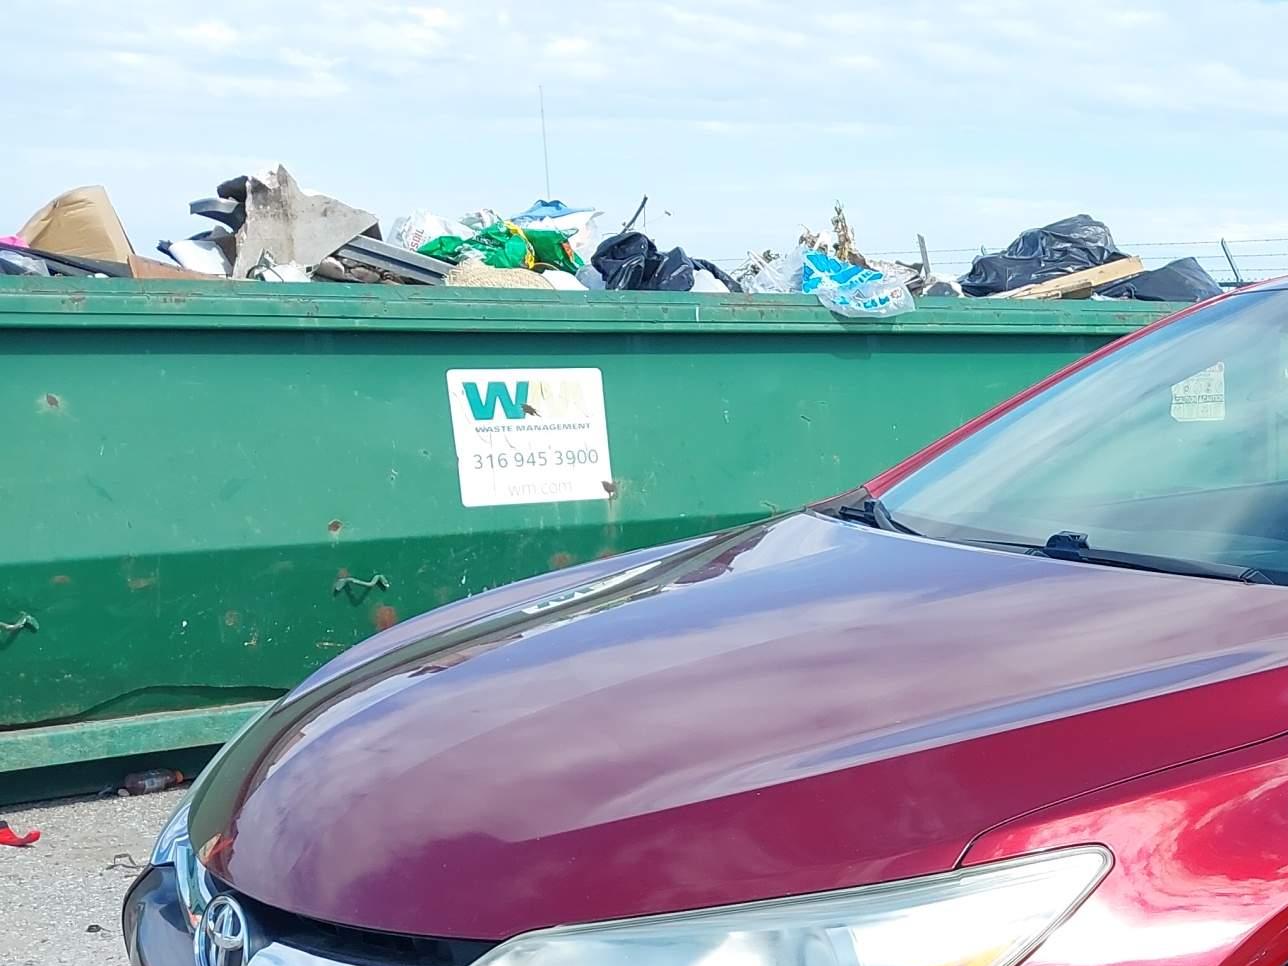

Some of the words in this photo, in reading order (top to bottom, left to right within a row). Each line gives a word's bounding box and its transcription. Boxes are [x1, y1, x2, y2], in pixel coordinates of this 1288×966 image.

[474, 424, 513, 433] WASTE
[516, 422, 591, 432] MANAGEMENT
[472, 453, 509, 470] 316
[514, 451, 548, 467] 945
[554, 448, 599, 465] 3900
[507, 480, 573, 497] wm.com
